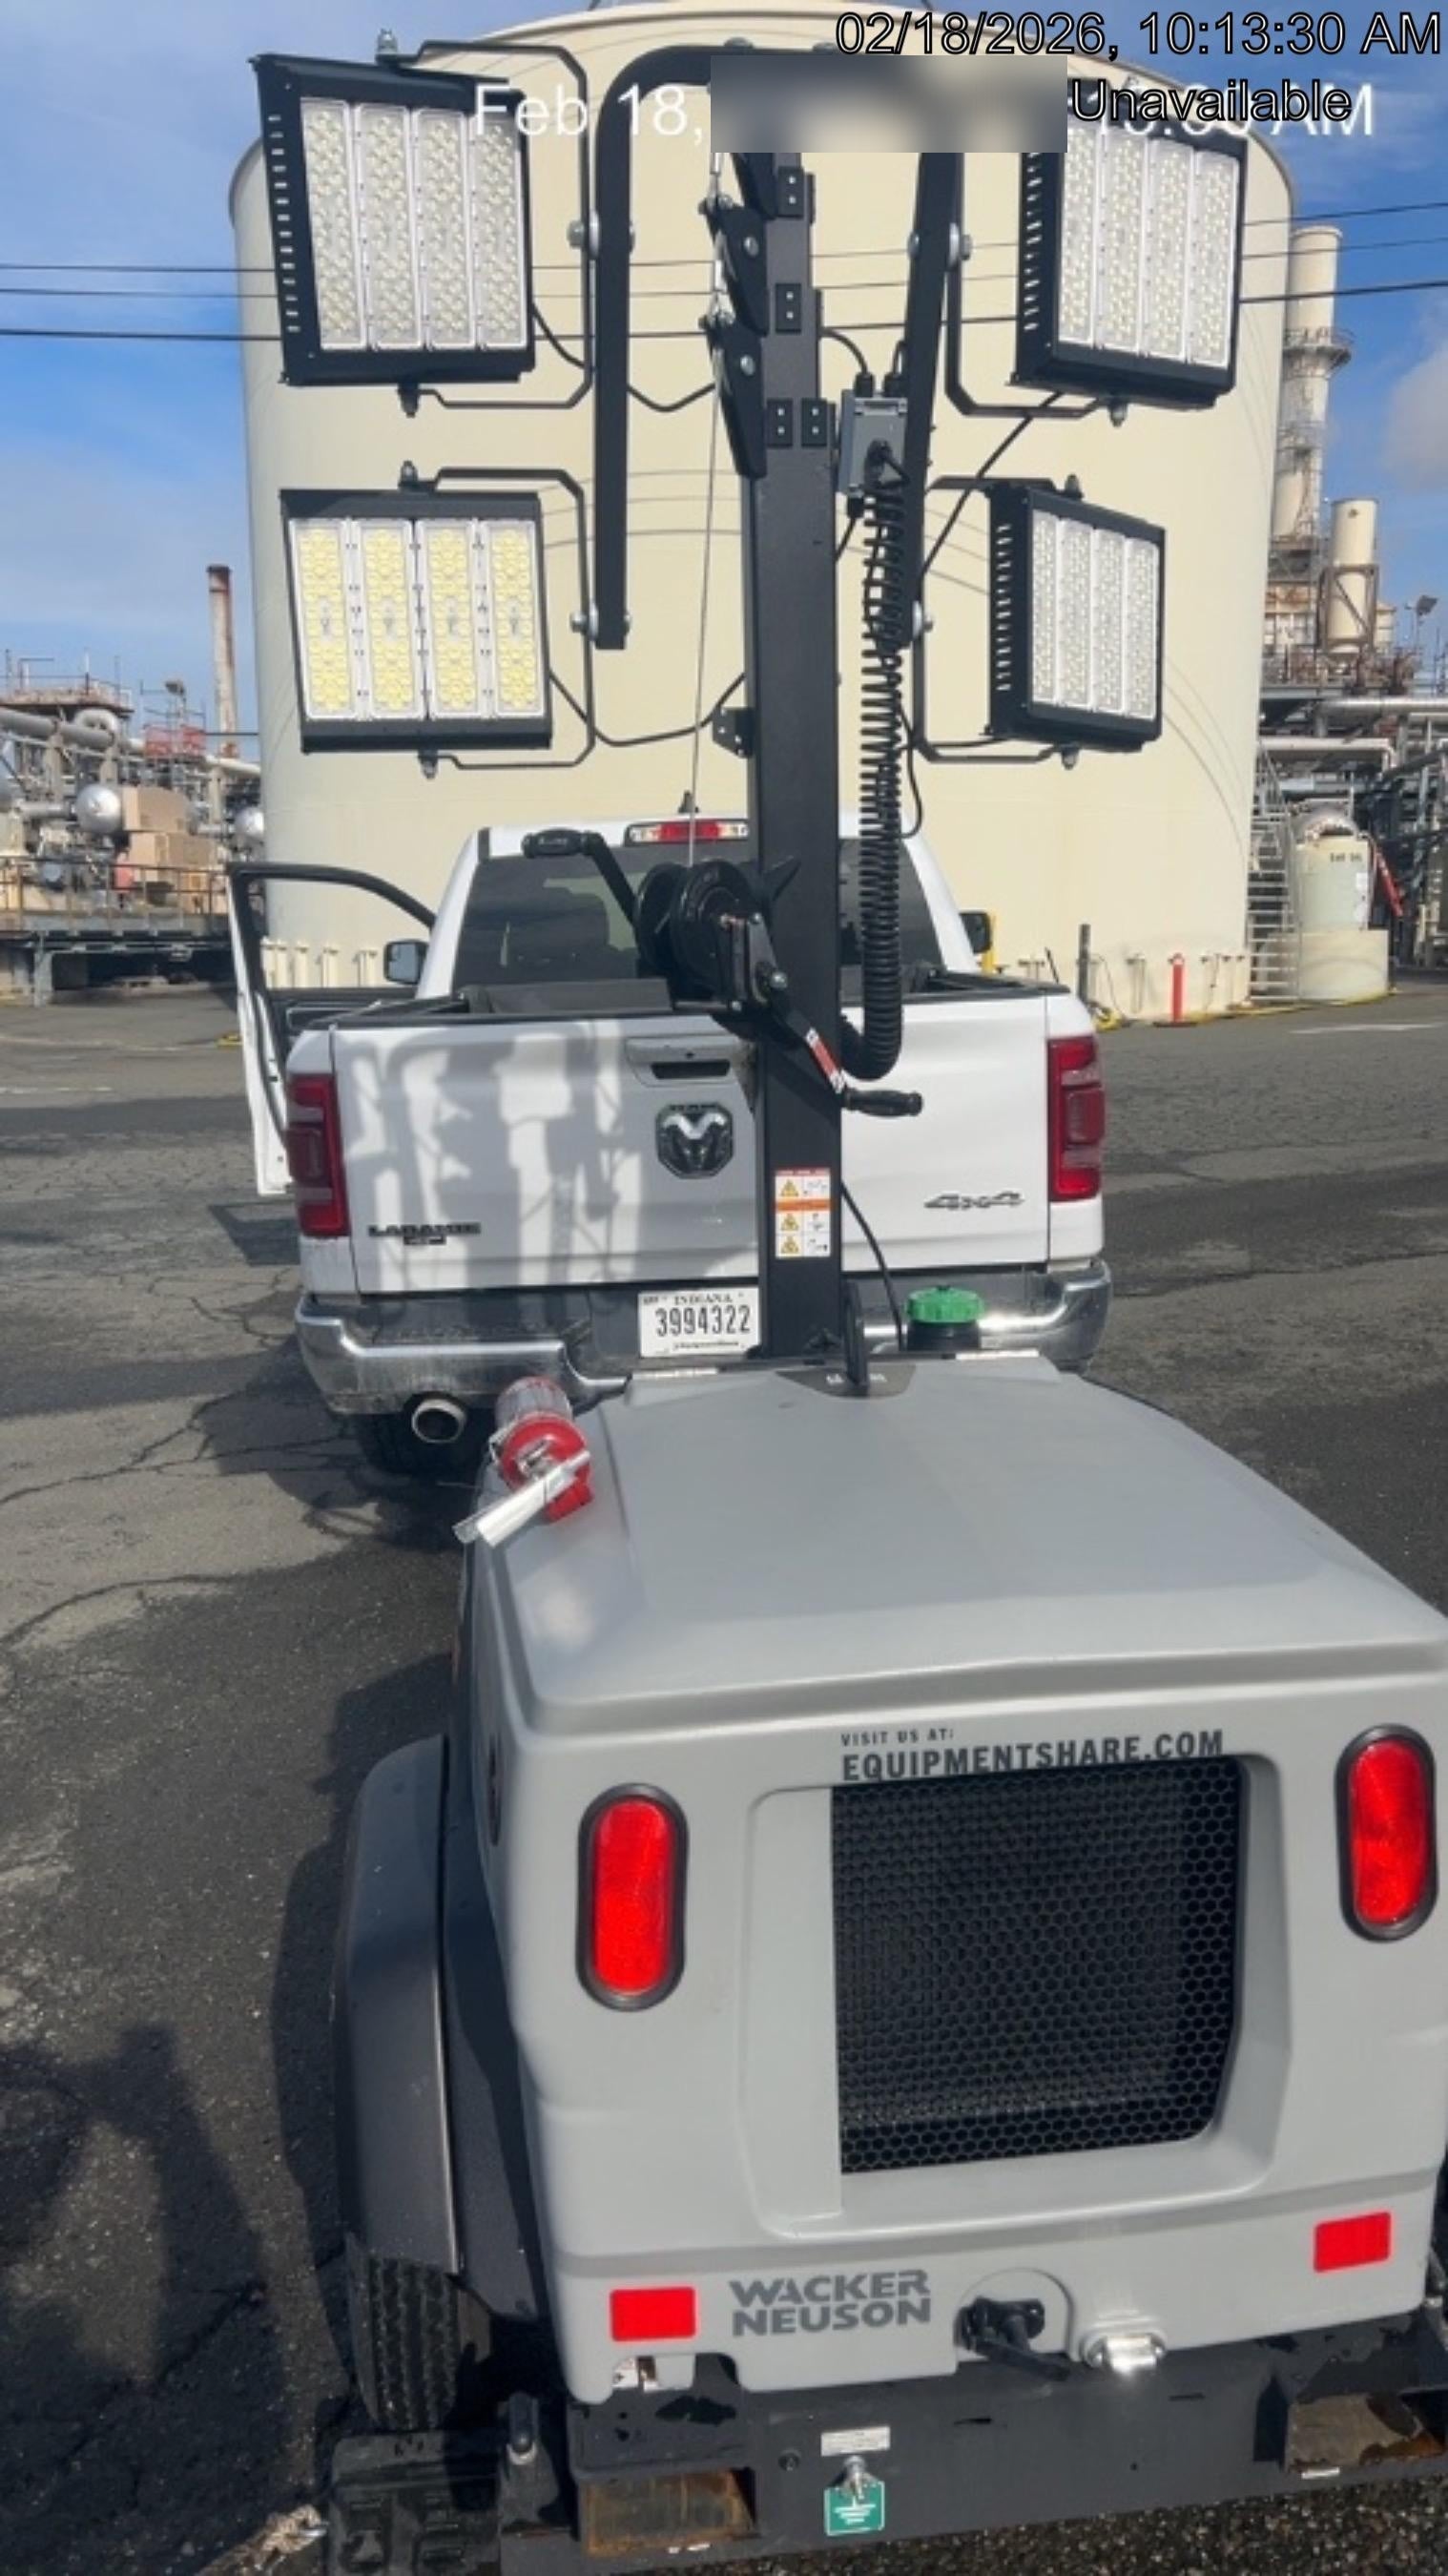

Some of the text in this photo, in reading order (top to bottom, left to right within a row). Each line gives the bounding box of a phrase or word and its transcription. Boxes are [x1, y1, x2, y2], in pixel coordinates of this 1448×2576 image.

[654, 1304, 751, 1337] 3994322
[840, 1728, 953, 1747] VISIT US AT:
[842, 1730, 1224, 1782] EQUIPMENTSHARE.COM
[728, 2269, 931, 2308] WACKER
[732, 2297, 931, 2337] NEUSON
